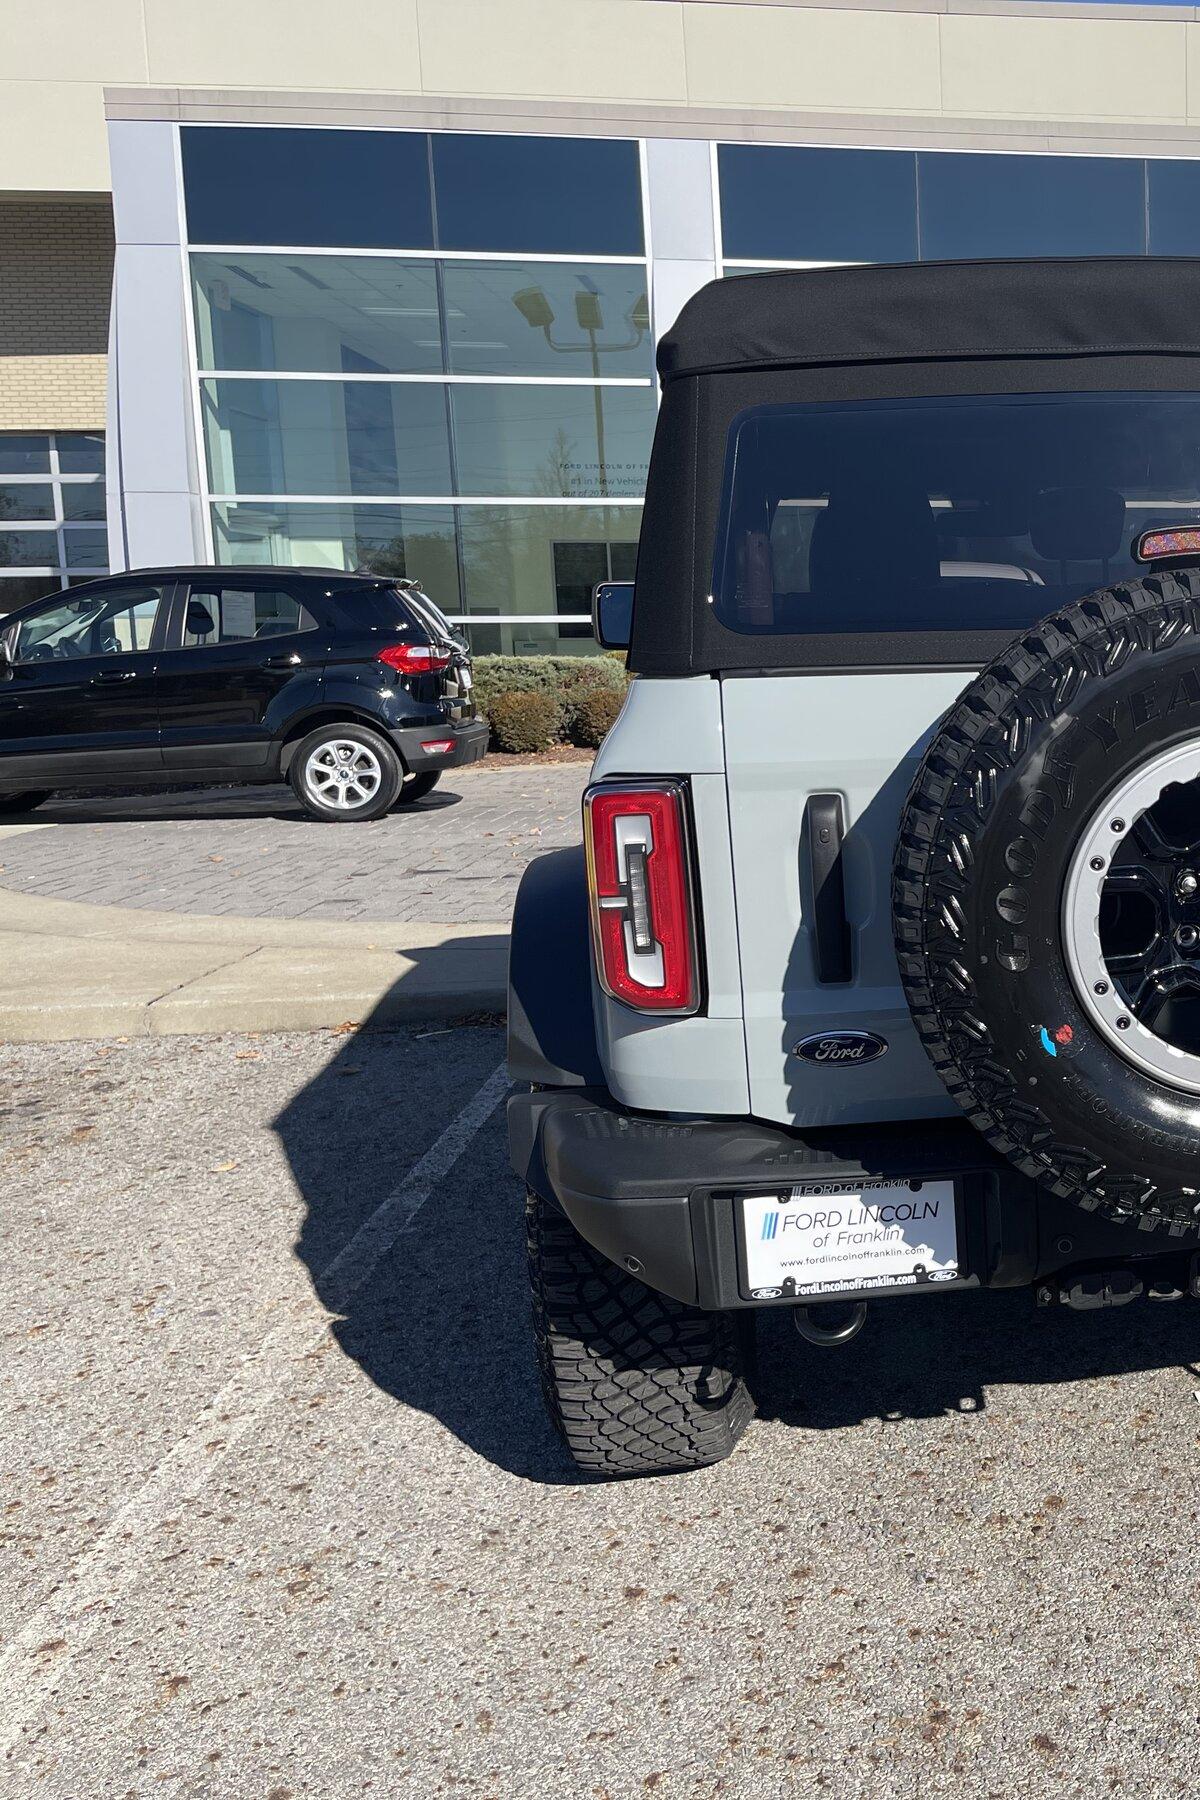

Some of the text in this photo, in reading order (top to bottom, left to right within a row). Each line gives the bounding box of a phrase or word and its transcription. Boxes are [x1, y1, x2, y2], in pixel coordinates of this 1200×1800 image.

[815, 1039, 865, 1060] Ford
[803, 1179, 911, 1196] FORD of Franklin
[782, 1201, 939, 1232] FORD LINCOLN
[812, 1228, 900, 1248] of Franklin
[780, 1246, 926, 1268] www.fordlincolnoffranklin.com
[795, 1274, 917, 1296] FordLincolnofFranklin.com
